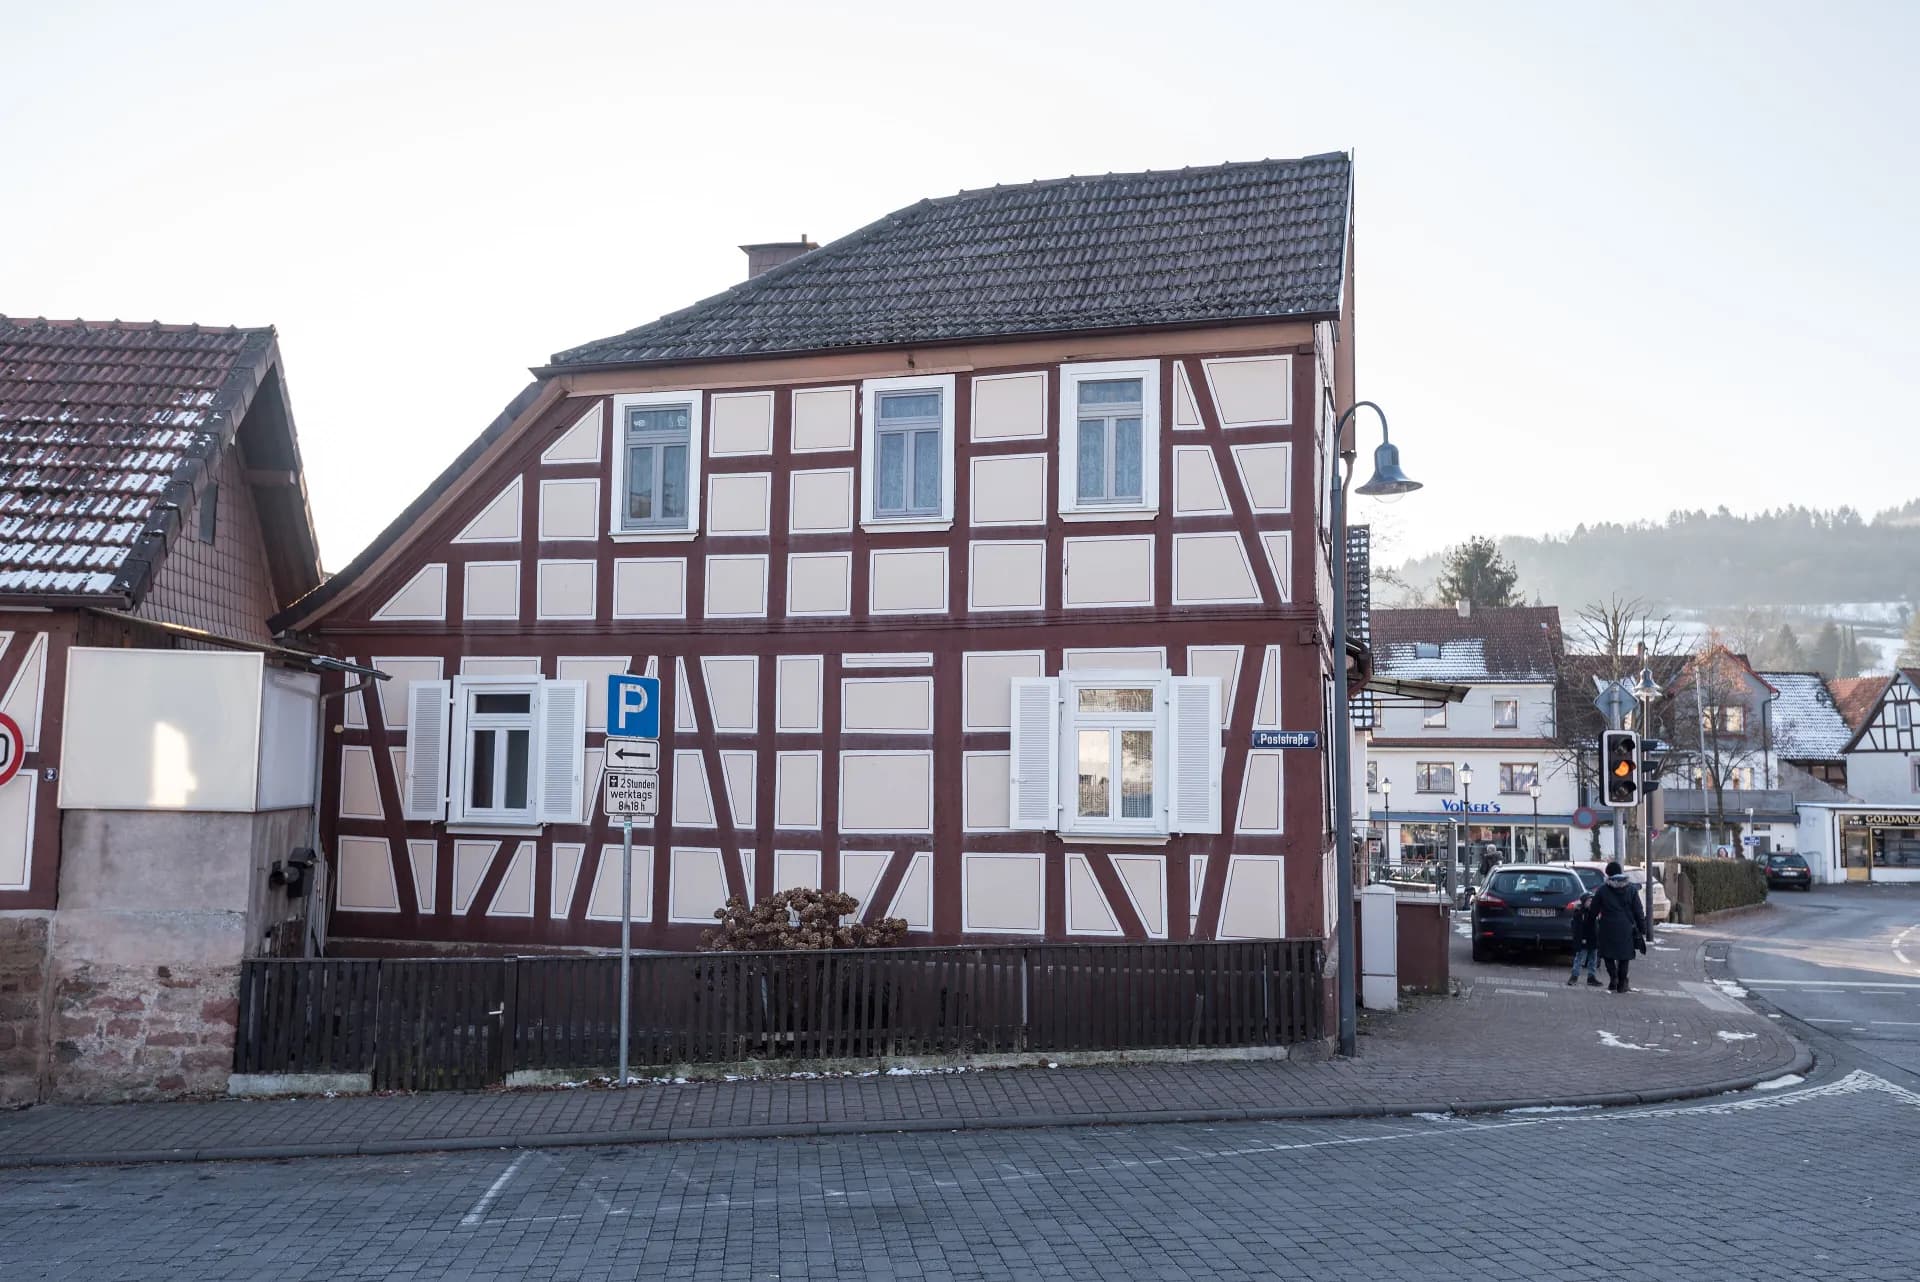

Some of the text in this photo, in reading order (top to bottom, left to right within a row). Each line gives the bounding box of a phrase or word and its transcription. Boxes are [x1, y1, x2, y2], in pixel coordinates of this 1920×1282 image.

[618, 682, 648, 729] P
[1260, 733, 1309, 747] Poststraße
[47, 769, 55, 779] 2
[620, 778, 655, 789] 2 Stunden
[610, 789, 653, 801] werktags
[640, 801, 645, 811] h
